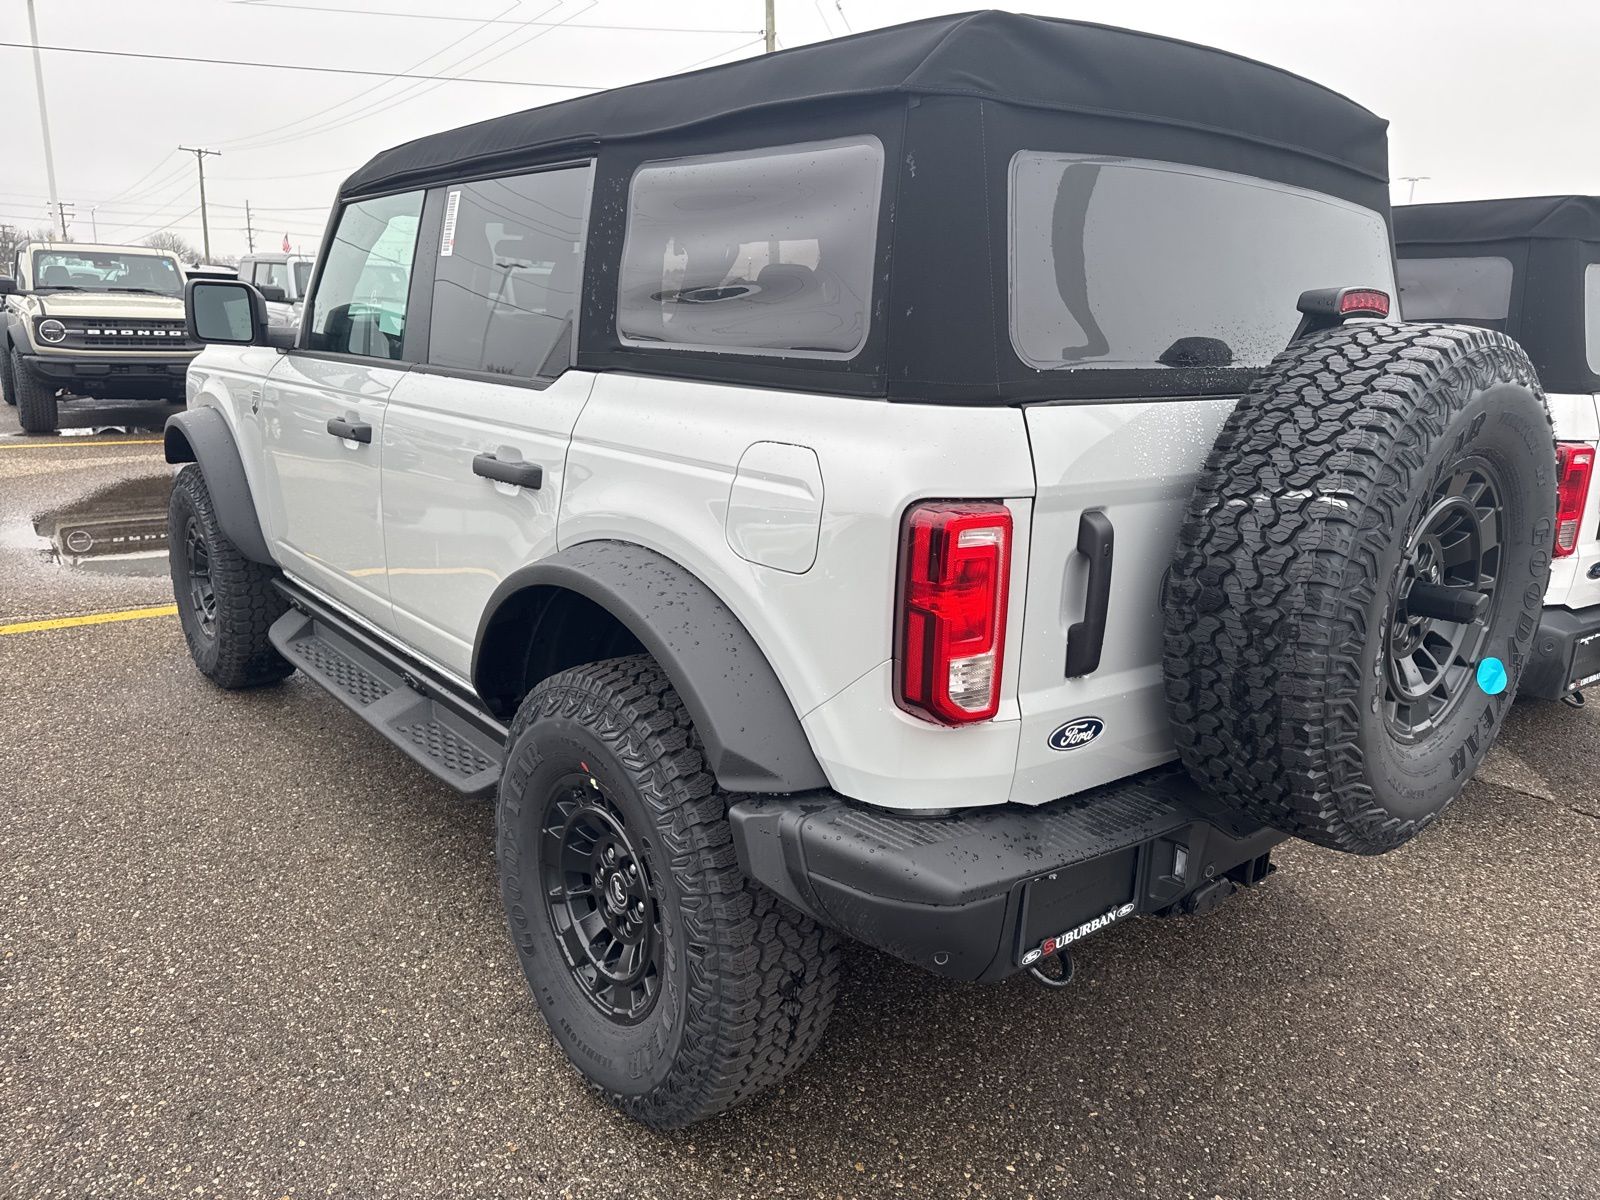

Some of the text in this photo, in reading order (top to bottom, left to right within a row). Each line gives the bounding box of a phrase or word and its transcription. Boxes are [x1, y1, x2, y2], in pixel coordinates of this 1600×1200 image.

[87, 329, 182, 337] BRONCO
[1060, 722, 1096, 747] Ford
[1042, 910, 1117, 957] SUBURBAN
